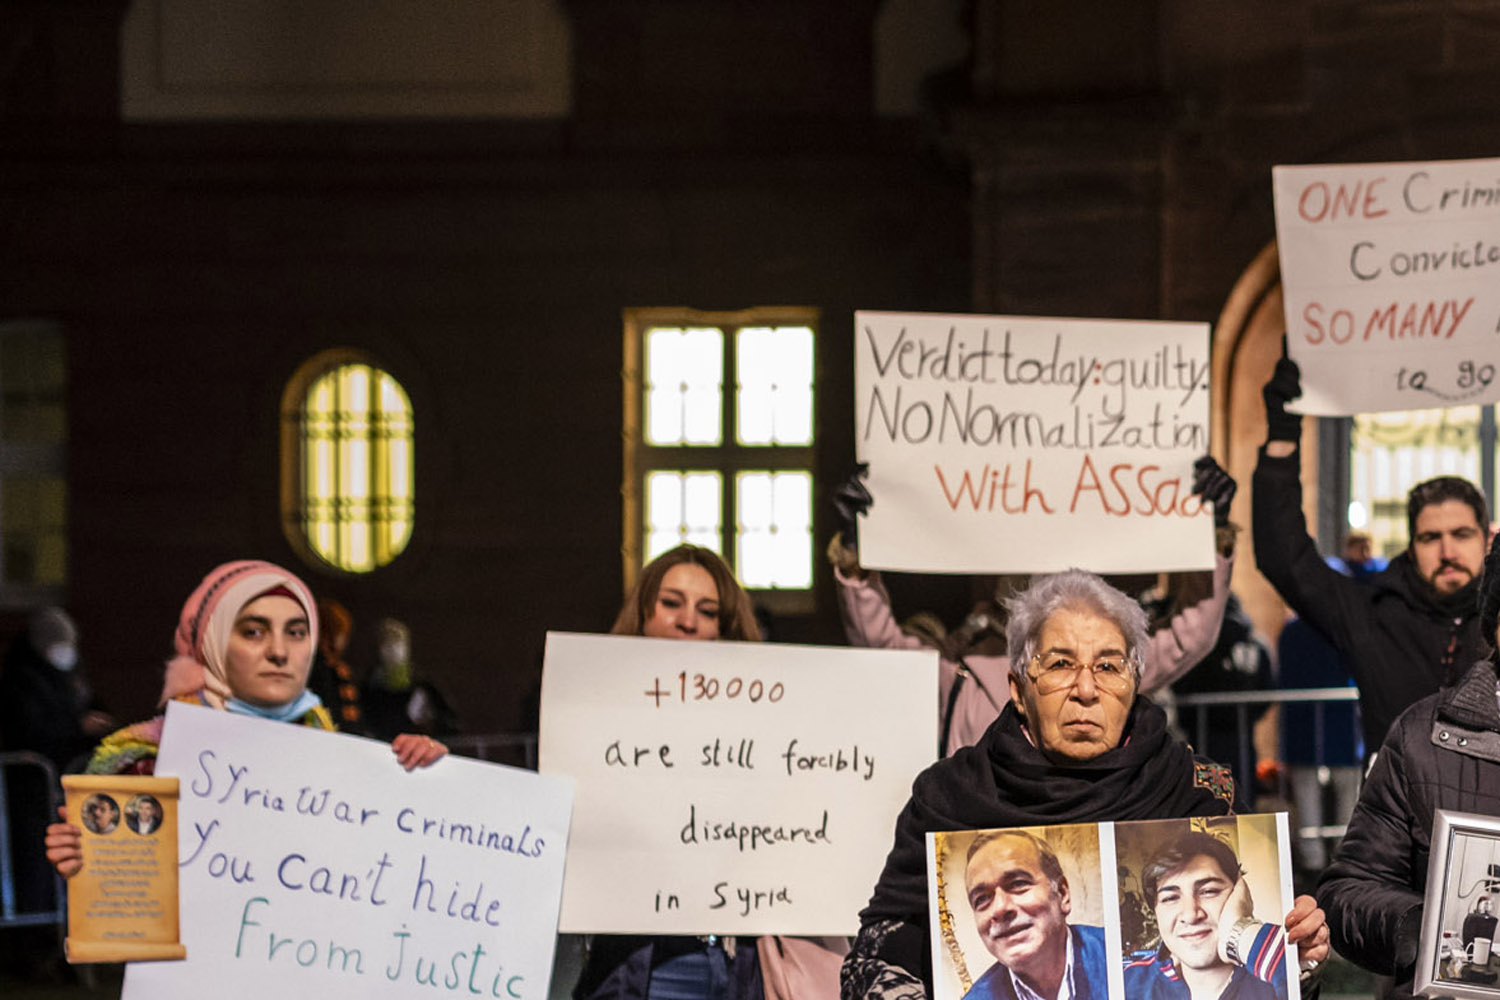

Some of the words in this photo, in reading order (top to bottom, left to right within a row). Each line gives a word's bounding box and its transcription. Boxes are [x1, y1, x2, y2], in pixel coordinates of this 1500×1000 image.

[1298, 177, 1389, 223] ONE
[1303, 302, 1355, 345] SO
[1362, 298, 1475, 342] MANY
[865, 325, 996, 384] Verdict
[1395, 367, 1428, 391] to
[1457, 360, 1497, 389] go
[935, 458, 1056, 514] With
[644, 671, 785, 708] +130000
[604, 740, 674, 769] are
[700, 737, 755, 770] still
[782, 739, 875, 781] forcibly
[296, 785, 378, 827] War
[680, 805, 832, 852] disappeared
[179, 819, 254, 884] You
[277, 852, 393, 907] Can't
[412, 855, 500, 927] hide
[655, 891, 679, 913] in
[709, 882, 792, 916] Syria
